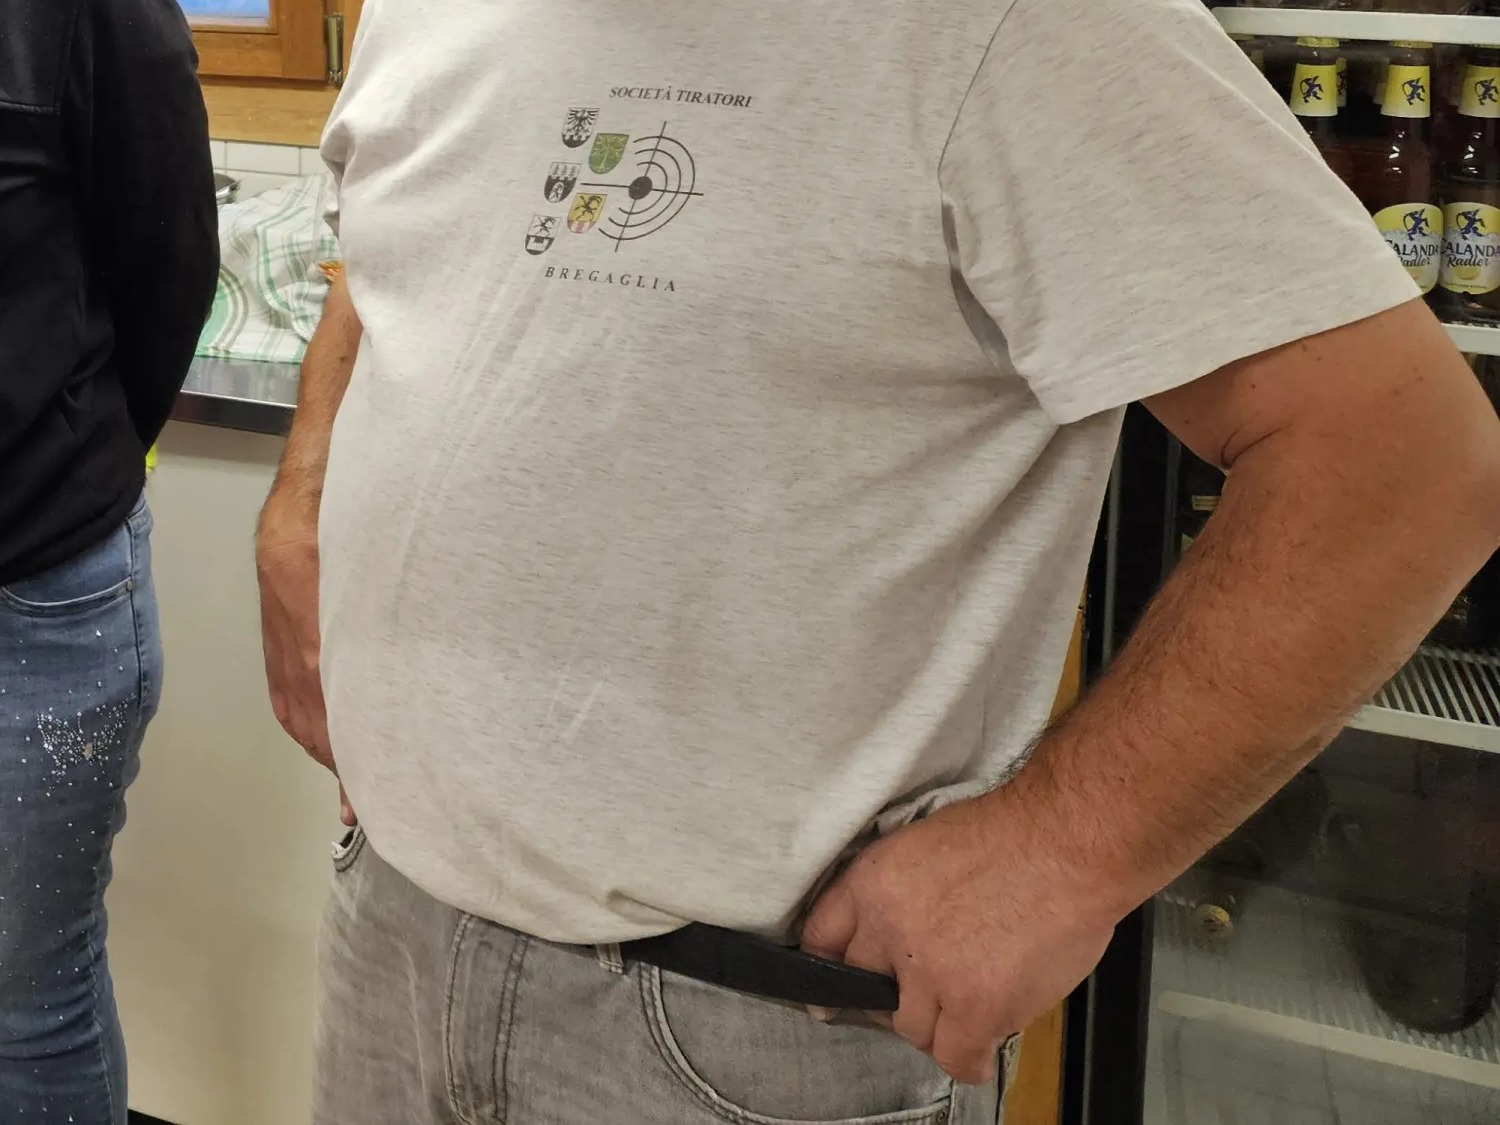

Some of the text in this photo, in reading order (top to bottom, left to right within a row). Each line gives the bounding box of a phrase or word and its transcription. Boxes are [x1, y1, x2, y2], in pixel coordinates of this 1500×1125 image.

[676, 89, 752, 107] TIRATORI
[1398, 255, 1431, 267] adler
[1447, 254, 1489, 267] Radler
[545, 266, 676, 292] BREGAGLIA
